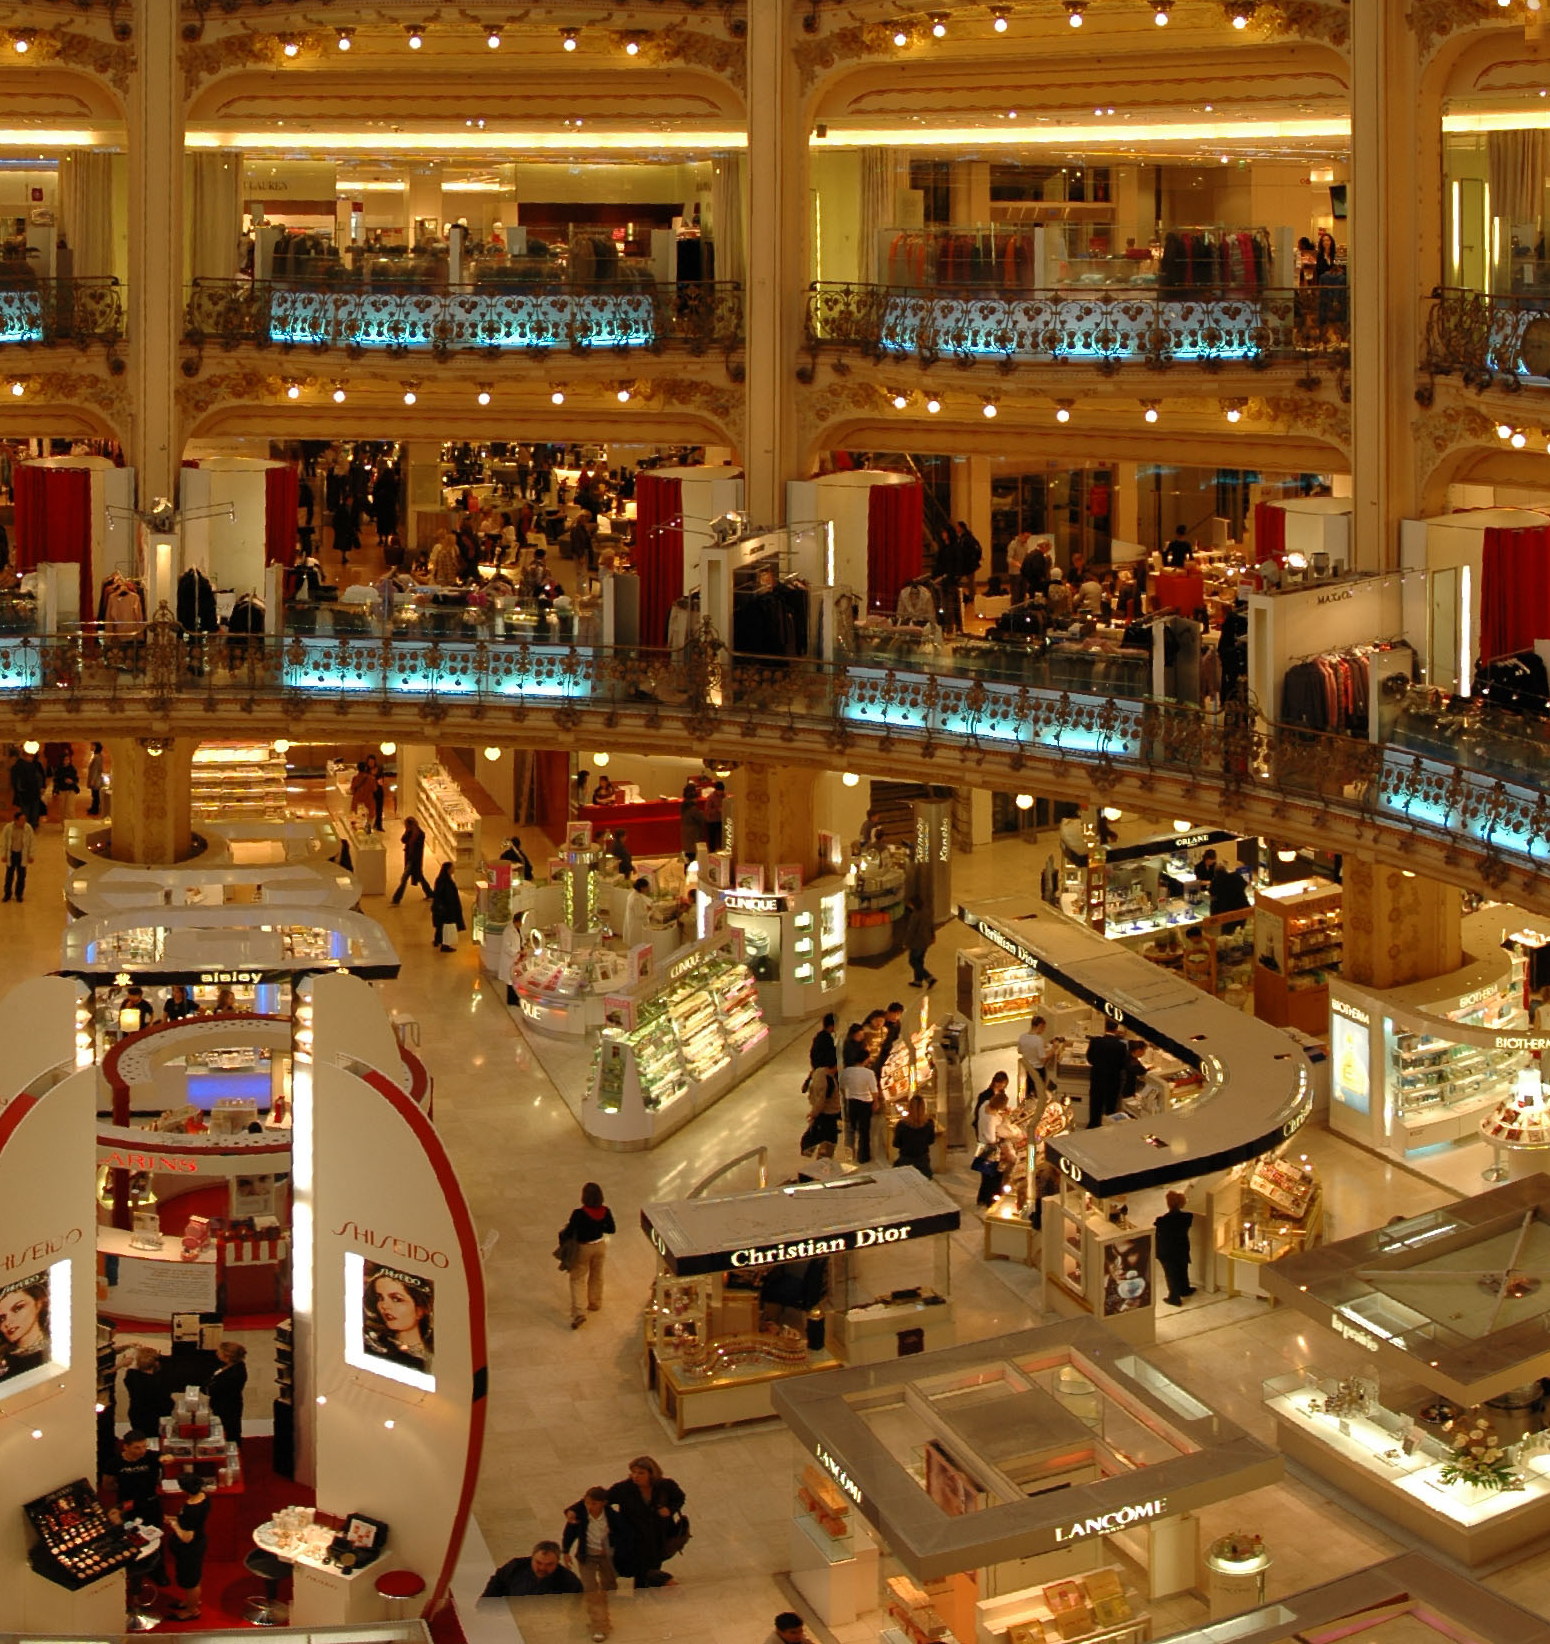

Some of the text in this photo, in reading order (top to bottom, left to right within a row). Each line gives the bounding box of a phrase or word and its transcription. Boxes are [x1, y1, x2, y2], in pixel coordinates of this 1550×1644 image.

[939, 818, 948, 863] Kanebo
[724, 896, 778, 912] CLINIQUE
[330, 1220, 450, 1270] SHISEIDO
[730, 1224, 912, 1267] Christian Dior
[1054, 1497, 1168, 1543] LANCÔME
